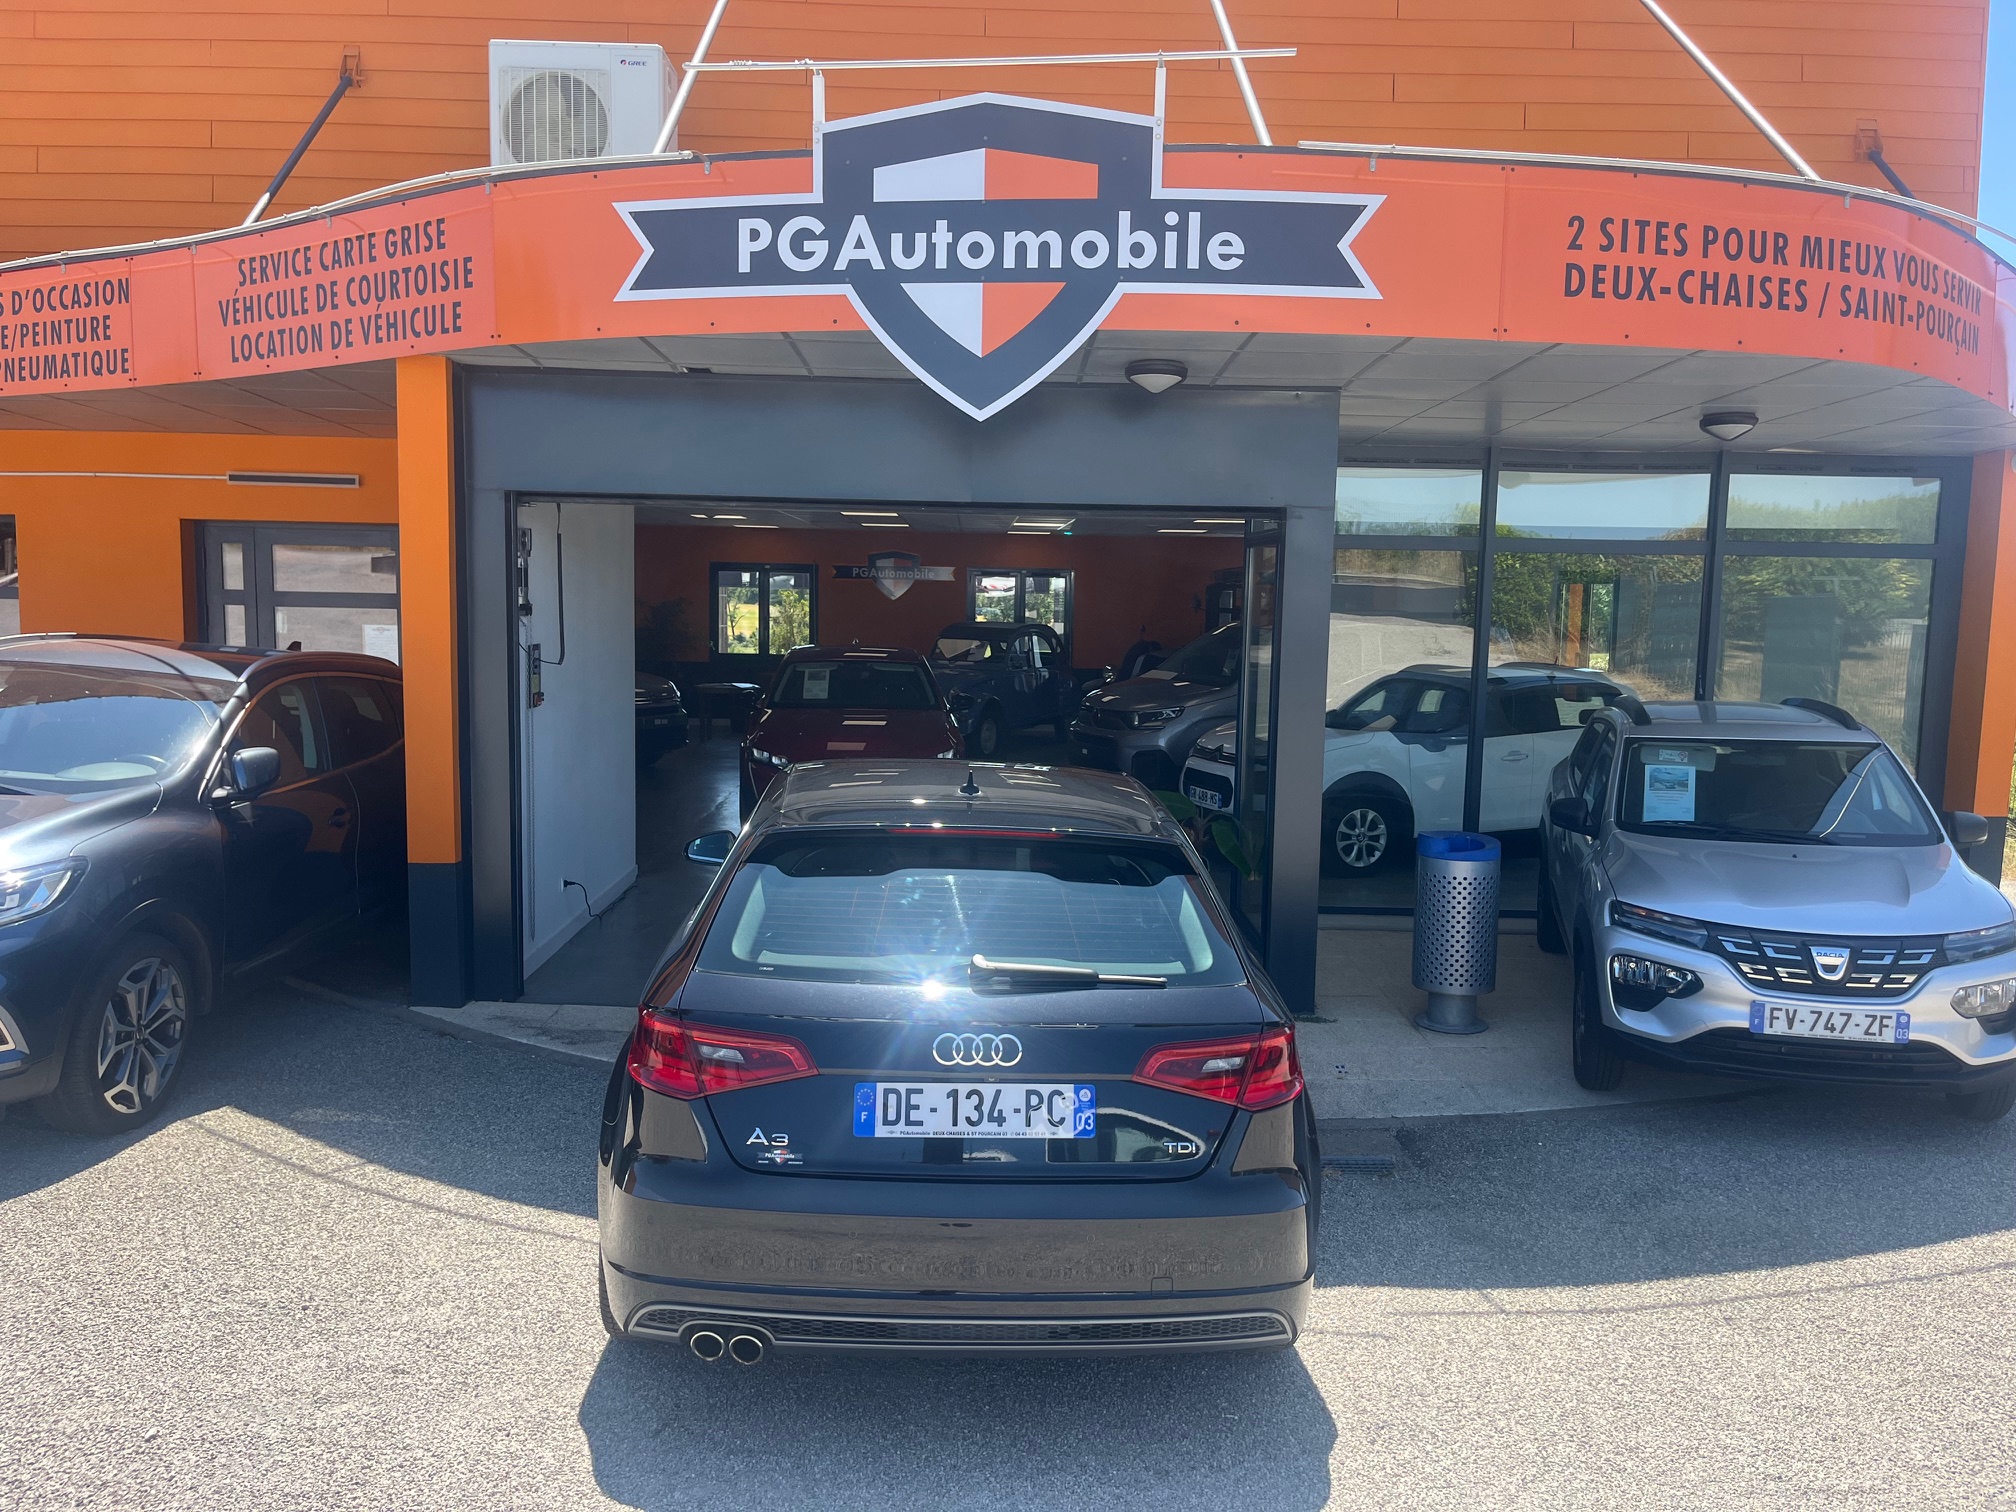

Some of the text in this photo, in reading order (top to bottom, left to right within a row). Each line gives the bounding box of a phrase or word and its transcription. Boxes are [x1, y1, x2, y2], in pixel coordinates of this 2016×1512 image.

[238, 217, 447, 288] SERVICE CARTE GRISE
[737, 210, 1246, 273] PGAutomobile
[1567, 215, 1982, 316] 2 SITES POUR MIEUX VOUS SERVIR
[11, 277, 130, 316] D'OCCASION
[218, 256, 474, 327] VÉHICULE DE COURTOISIE
[1564, 262, 1808, 313] DEUX-CHAISES
[1839, 284, 1980, 356] SAINT-POURÇAIN
[1, 314, 112, 352] E/PEINTURE
[230, 300, 463, 364] LOCATION DE VÉHICULE
[0, 347, 130, 383] NEUMATIQUE
[852, 567, 935, 579] PGAutomobile
[1768, 1007, 1893, 1037] FV-747-ZF
[1896, 1029, 1909, 1039] 03
[860, 1111, 868, 1123] F
[882, 1087, 1067, 1128] DE-134-PC
[1076, 1112, 1094, 1131] 03
[745, 1127, 789, 1146] A3
[1163, 1142, 1196, 1154] TDI
